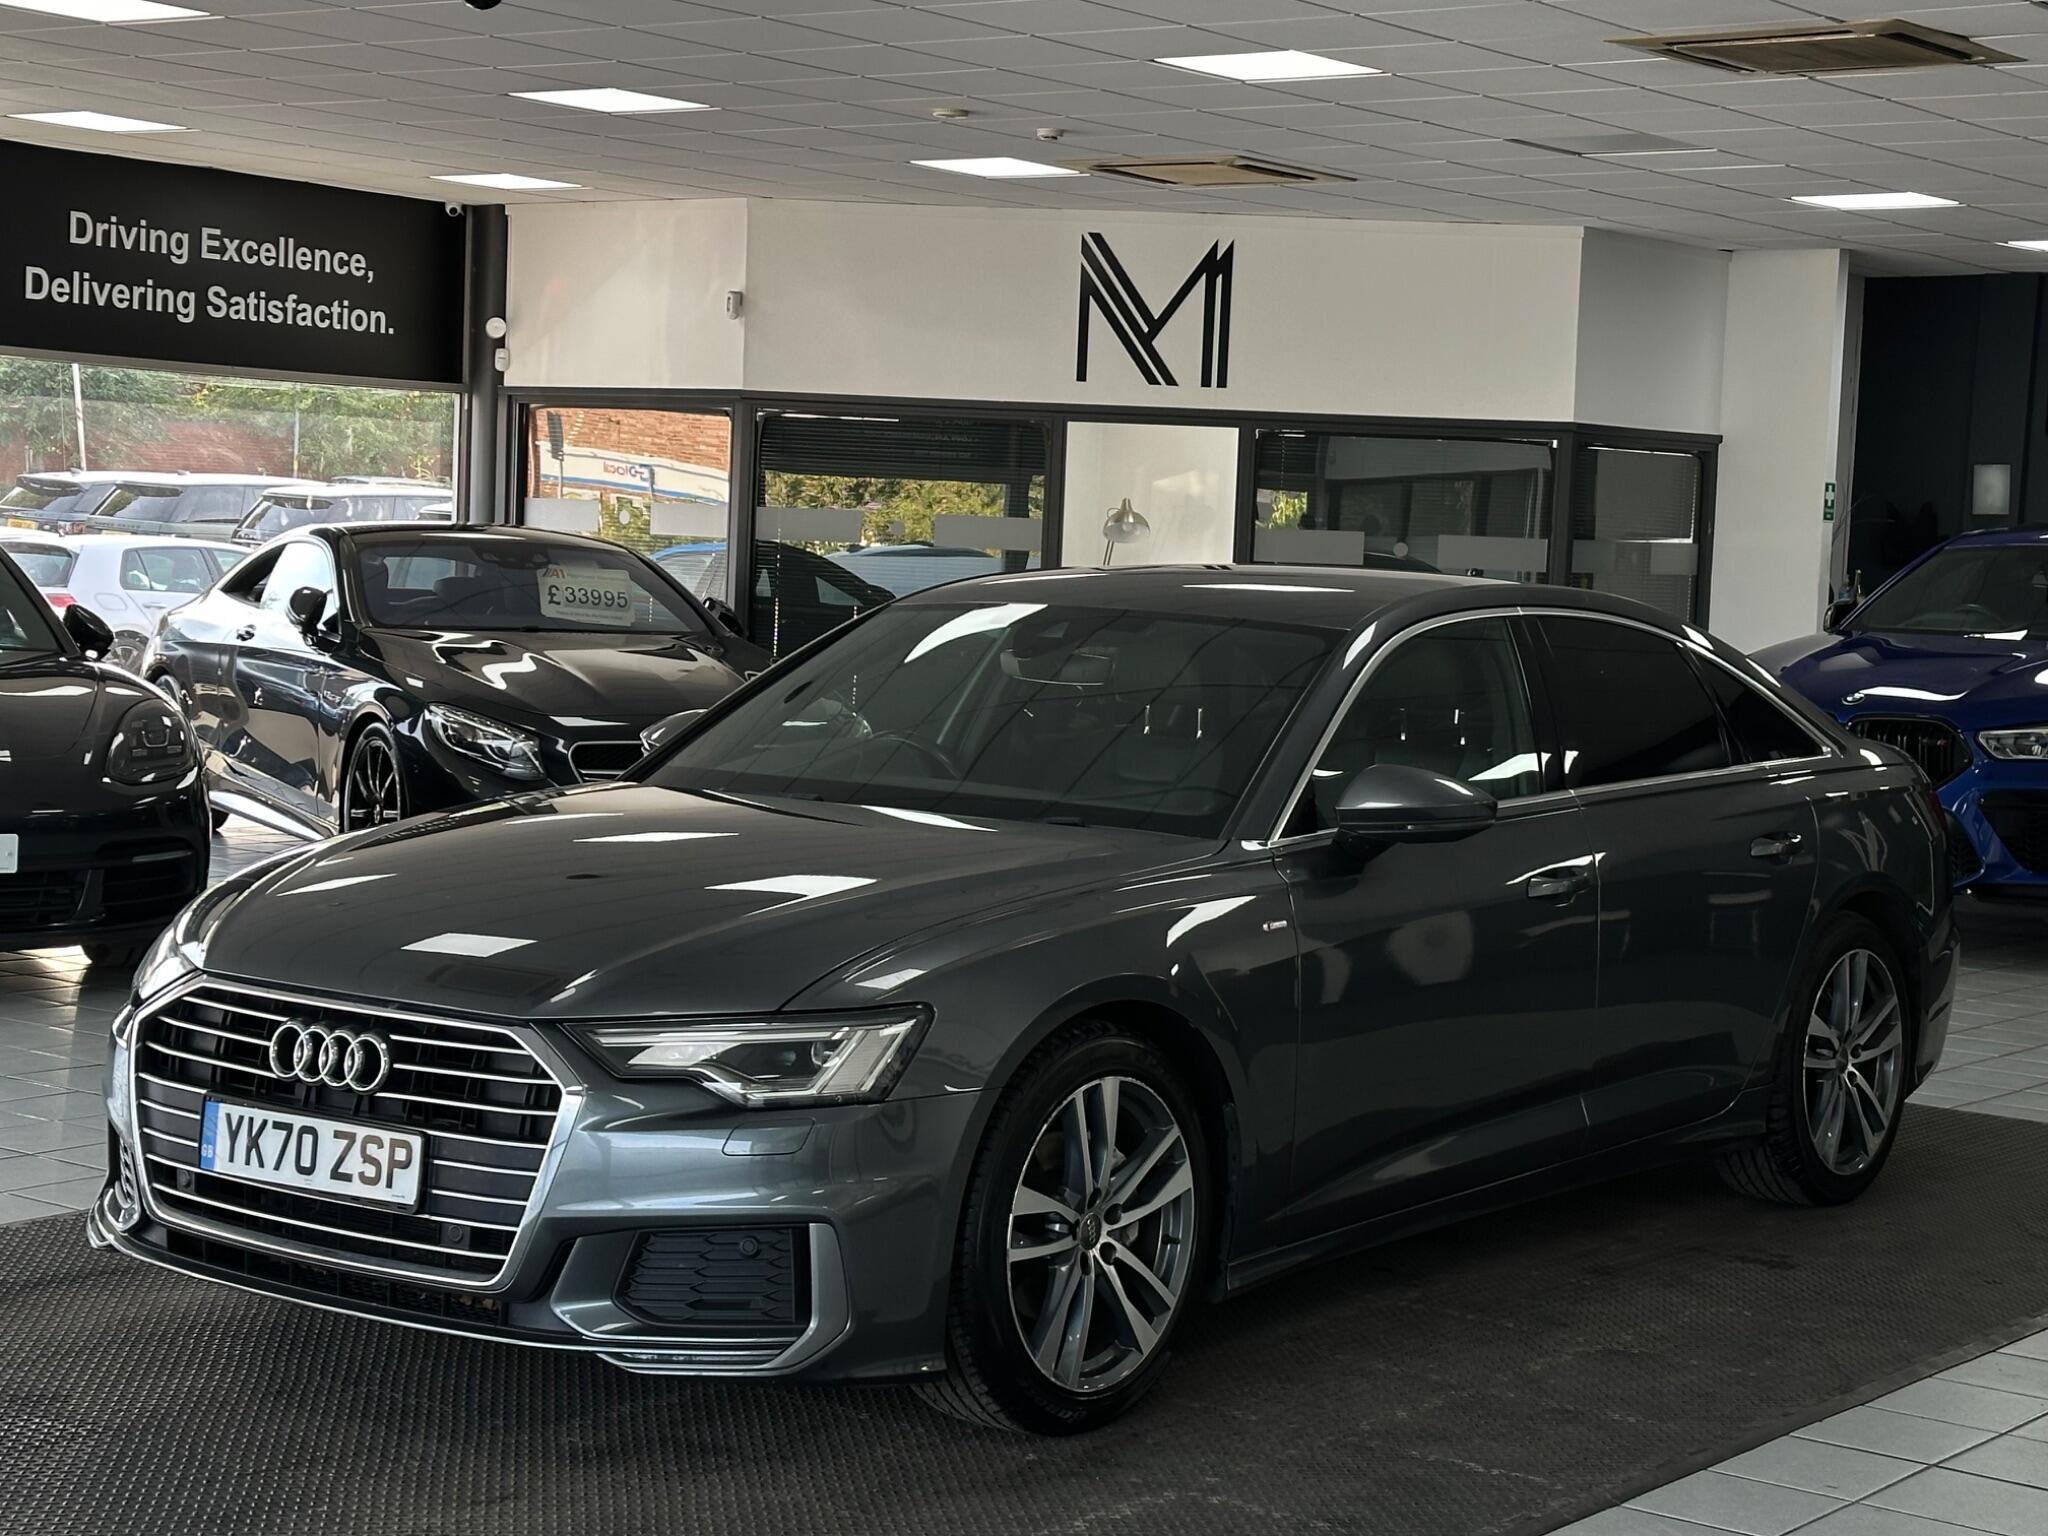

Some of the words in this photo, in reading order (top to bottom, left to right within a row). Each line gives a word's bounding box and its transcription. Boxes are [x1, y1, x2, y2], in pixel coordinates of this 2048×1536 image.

[69, 210, 190, 265] Driving
[200, 226, 375, 284] Excellence,
[24, 265, 196, 323] Delivering
[205, 285, 395, 335] Satisfaction.
[547, 584, 629, 609] £33995
[224, 1112, 319, 1177] YK70
[329, 1129, 414, 1190] ZSP
